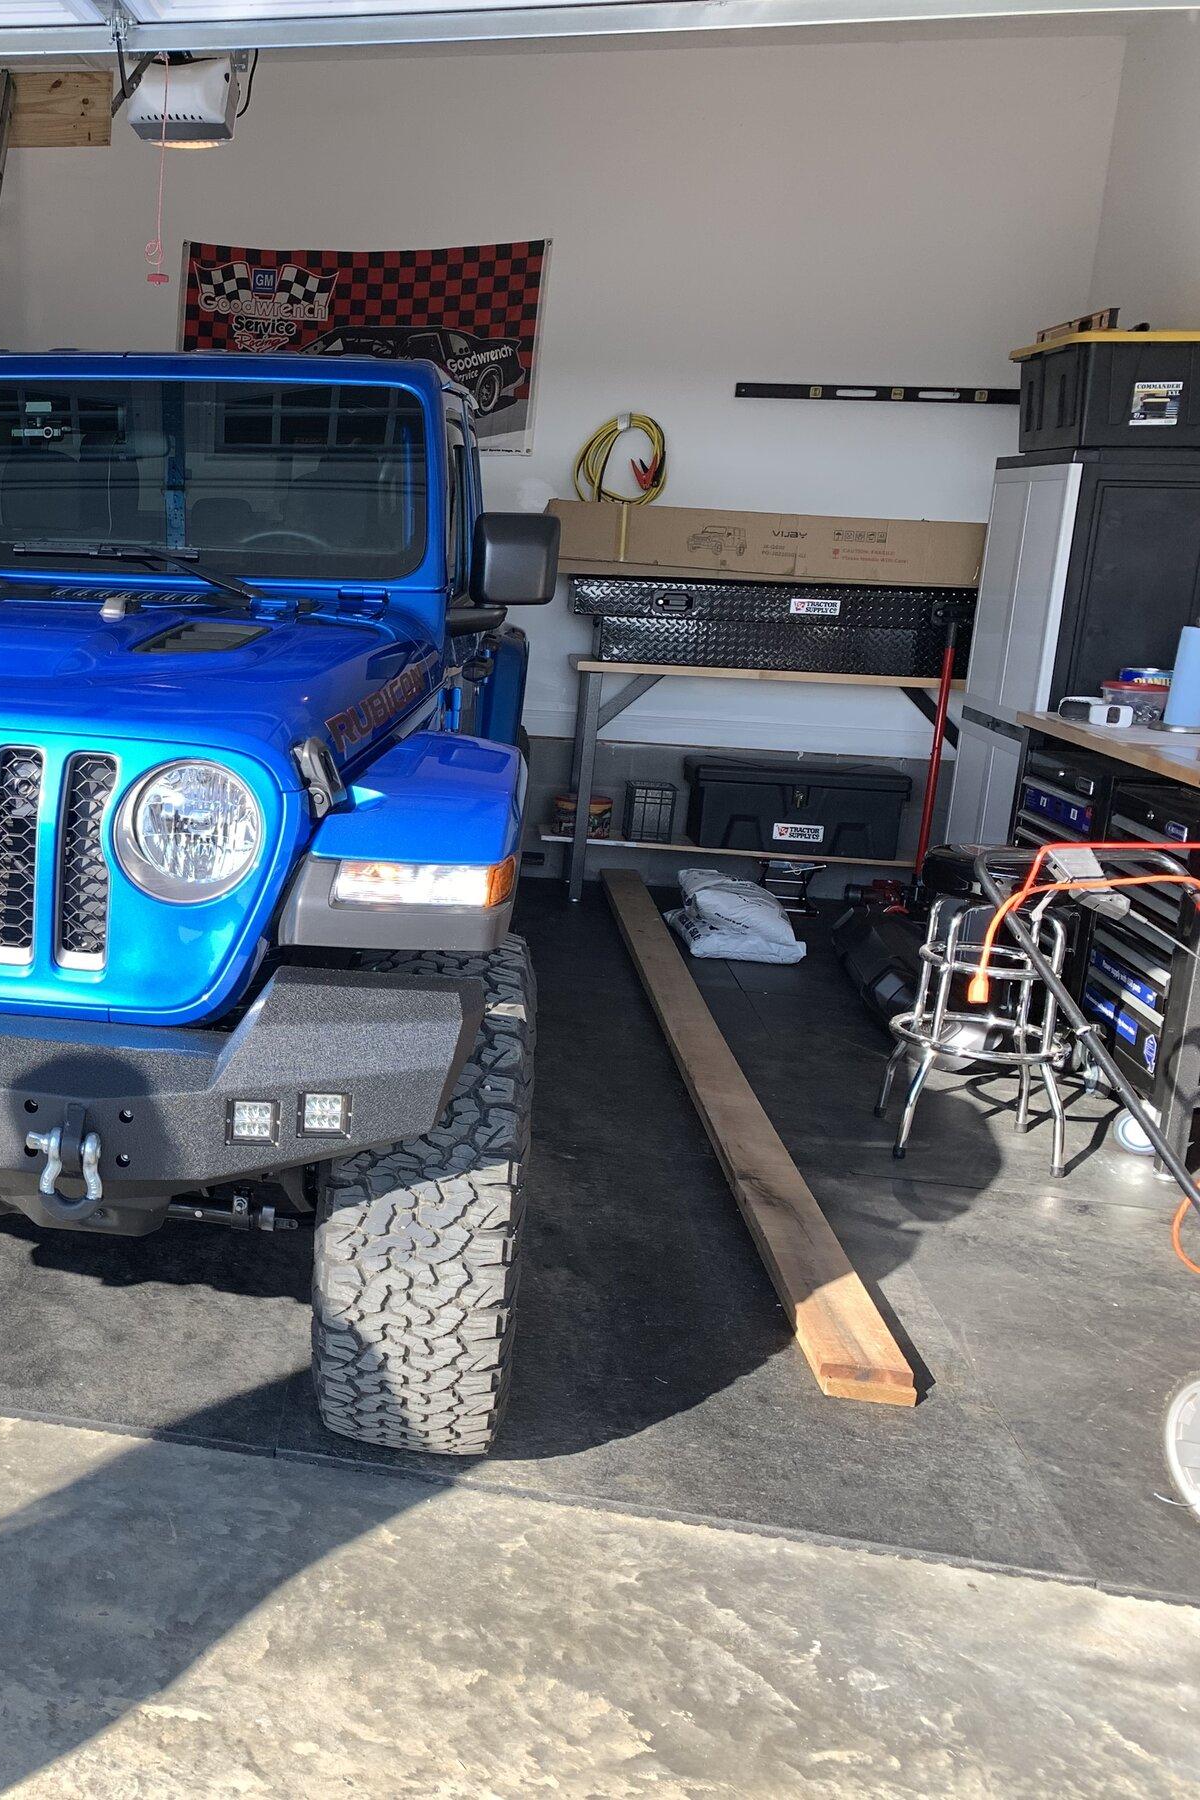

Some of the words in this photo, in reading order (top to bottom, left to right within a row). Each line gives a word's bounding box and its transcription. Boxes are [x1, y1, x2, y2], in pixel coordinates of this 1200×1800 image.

[255, 273, 274, 288] GM
[198, 292, 328, 320] Goodwrench
[232, 315, 296, 336] Service
[446, 344, 514, 373] Goodwrench
[457, 369, 479, 382] ervice
[324, 664, 424, 752] RUBICON
